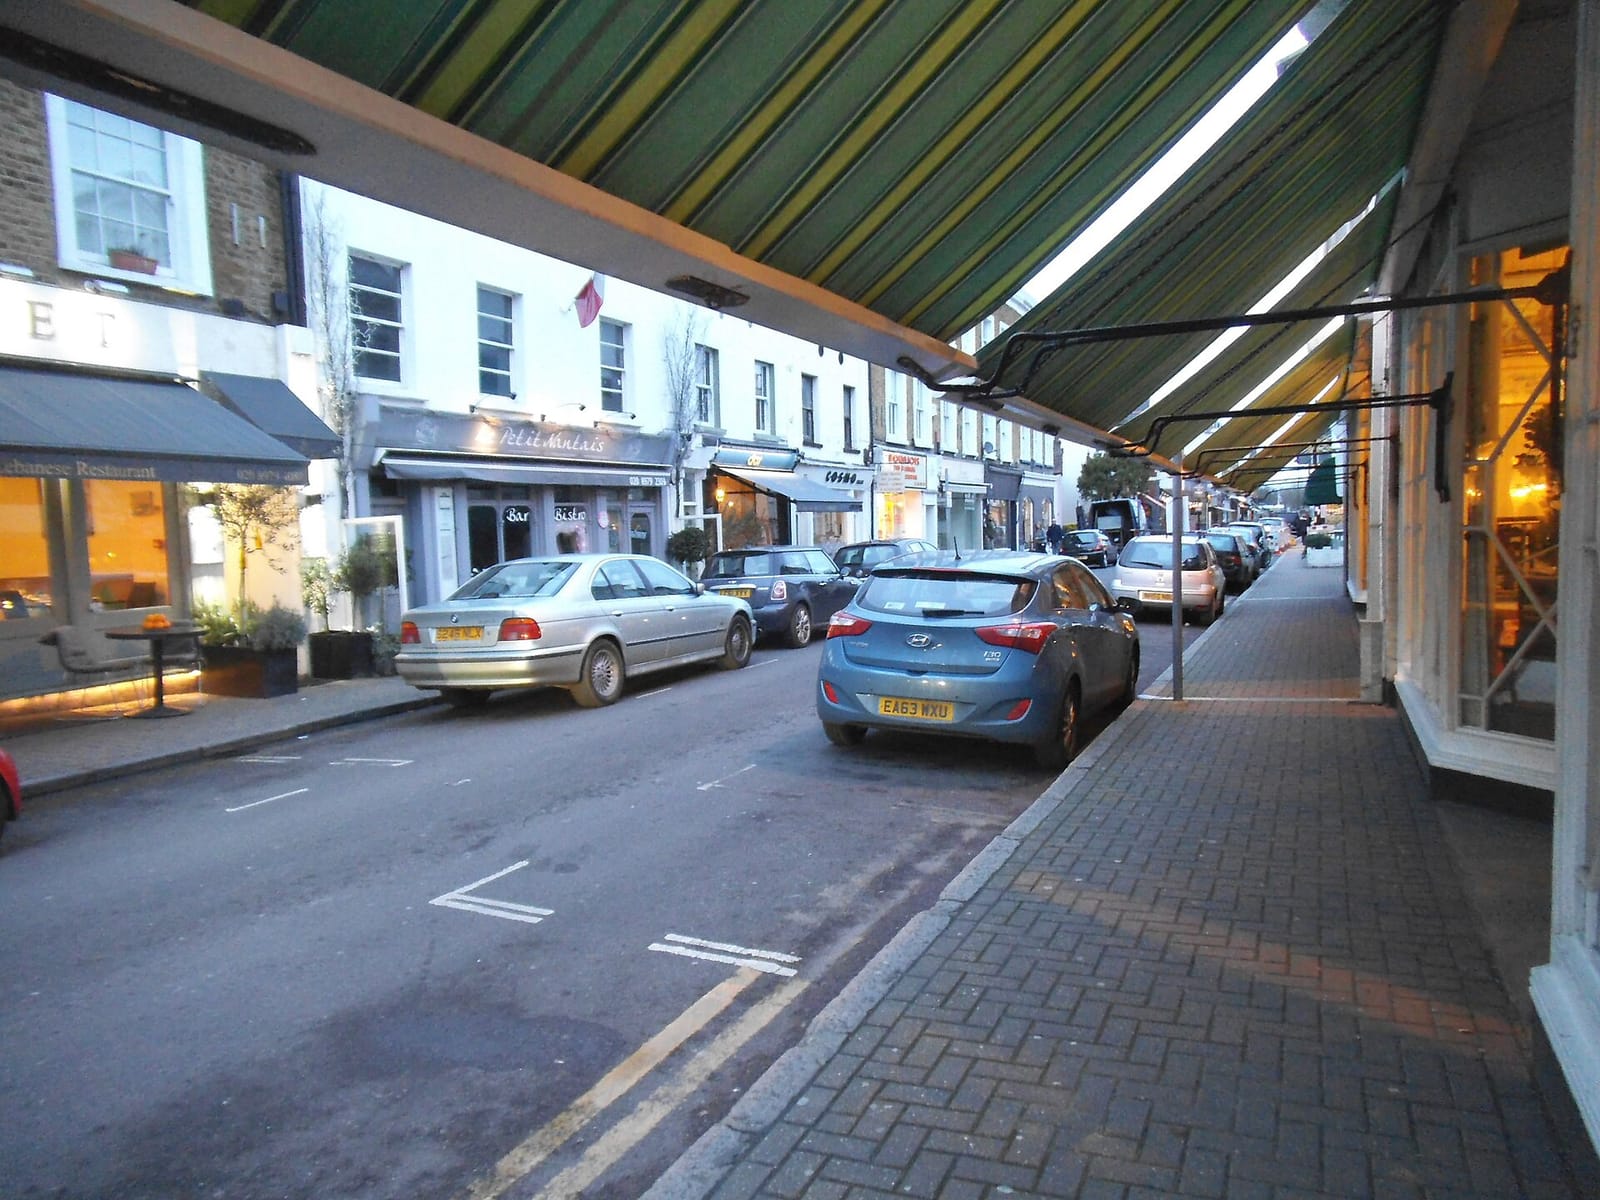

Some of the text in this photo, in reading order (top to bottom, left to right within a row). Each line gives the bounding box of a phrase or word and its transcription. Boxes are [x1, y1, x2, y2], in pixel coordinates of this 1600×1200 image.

[501, 426, 541, 447] Petit
[76, 461, 156, 478] Restaurant
[506, 508, 530, 521] Bar
[555, 507, 586, 521] Bistro
[884, 700, 918, 715] EA63
